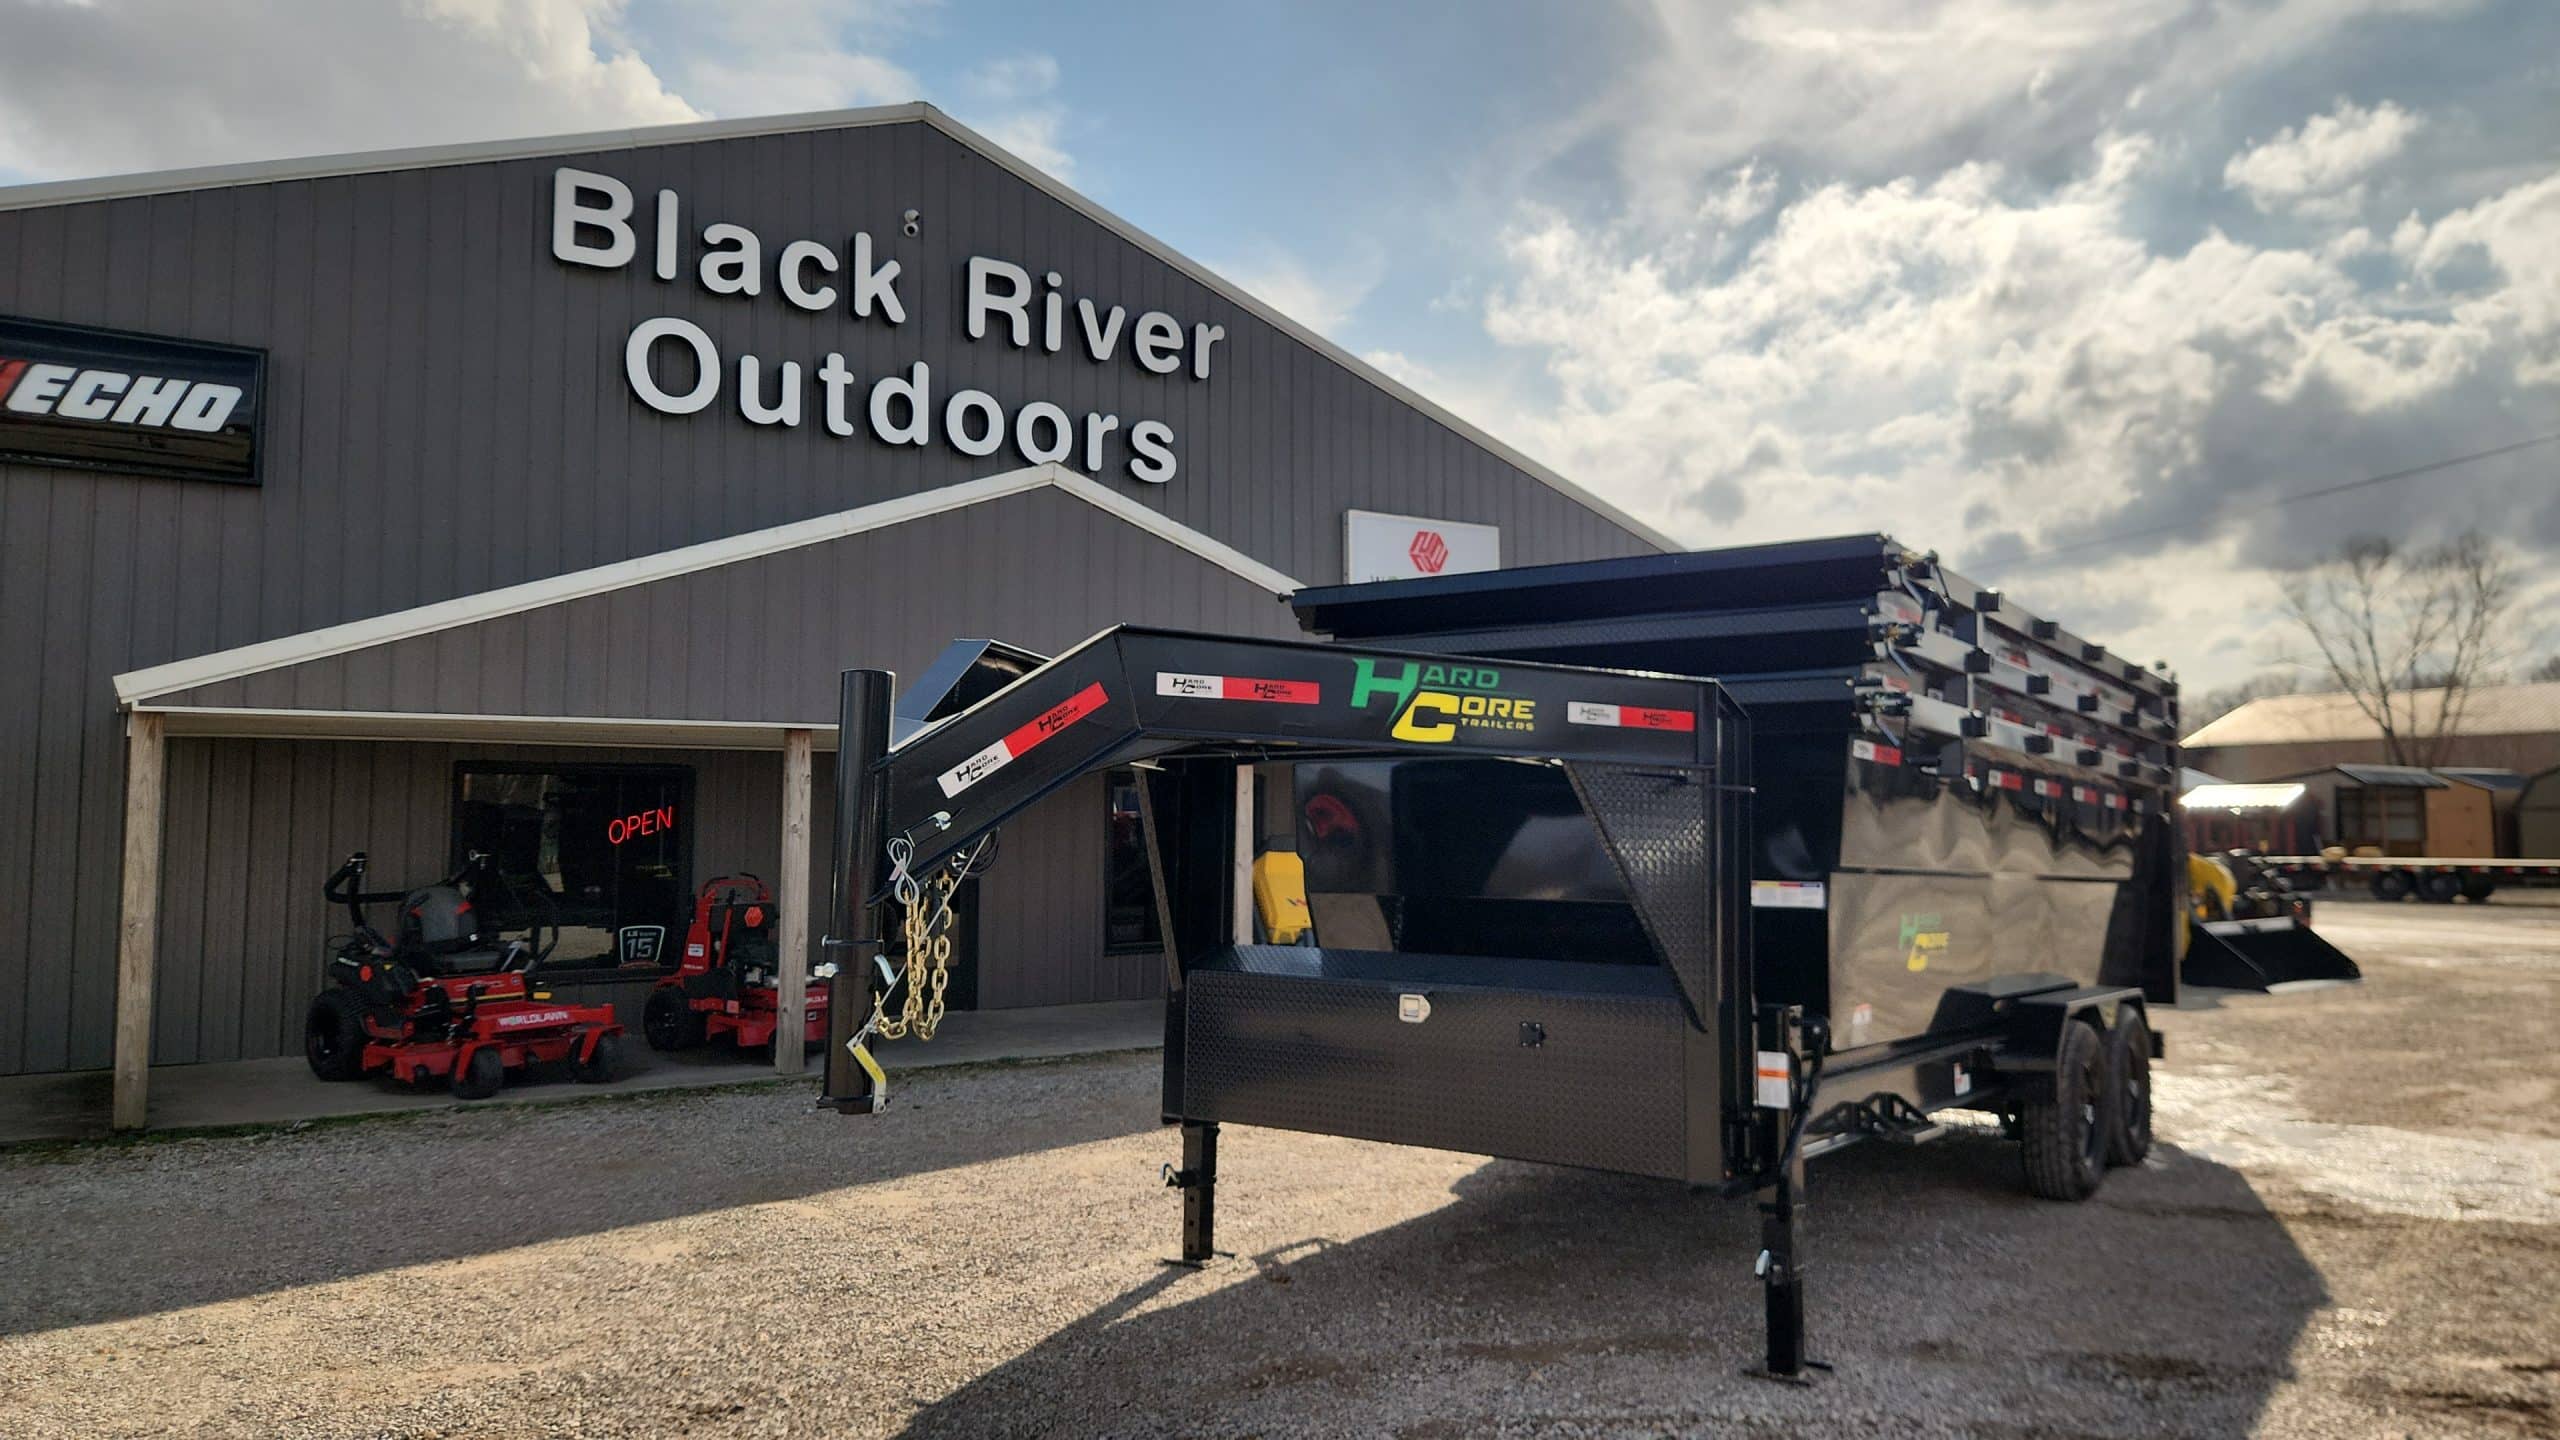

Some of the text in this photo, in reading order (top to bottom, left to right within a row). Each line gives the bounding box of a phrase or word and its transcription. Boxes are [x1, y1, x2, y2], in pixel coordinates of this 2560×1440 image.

[552, 167, 1226, 380] Black River
[6, 363, 243, 433] ECHO
[625, 316, 1178, 484] Outdoors
[1352, 657, 1499, 727] HARD
[1392, 691, 1536, 743] CORE
[1460, 716, 1536, 732] TRAILERS
[608, 805, 673, 844] OPEN
[627, 938, 654, 959] 15
